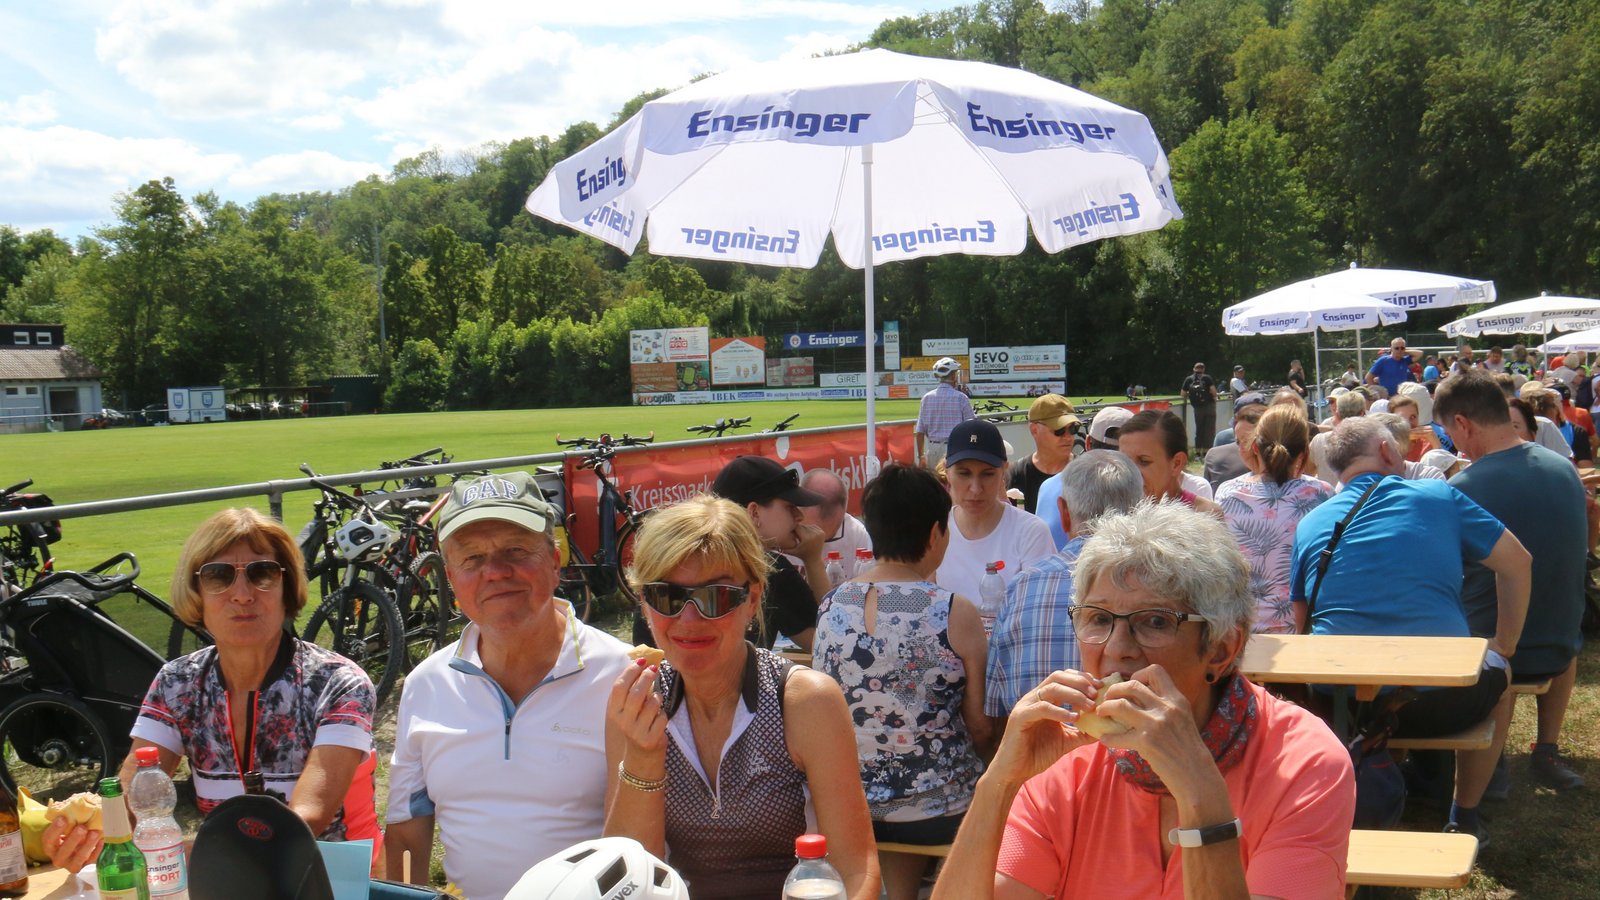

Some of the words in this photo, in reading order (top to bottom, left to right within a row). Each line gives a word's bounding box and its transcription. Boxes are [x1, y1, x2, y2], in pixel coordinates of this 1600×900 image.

[687, 105, 870, 139] Ensinger
[966, 101, 1116, 144] Ensinger
[1383, 293, 1436, 308] singer
[1259, 317, 1299, 328] Ensinger
[1322, 312, 1366, 323] Ensinger
[1477, 316, 1526, 328] Ensinger
[808, 334, 858, 346] Ensinger
[974, 351, 1009, 363] SEVO
[712, 392, 736, 401] IBEK
[462, 478, 519, 506] GAP
[147, 870, 180, 883] SPORT
